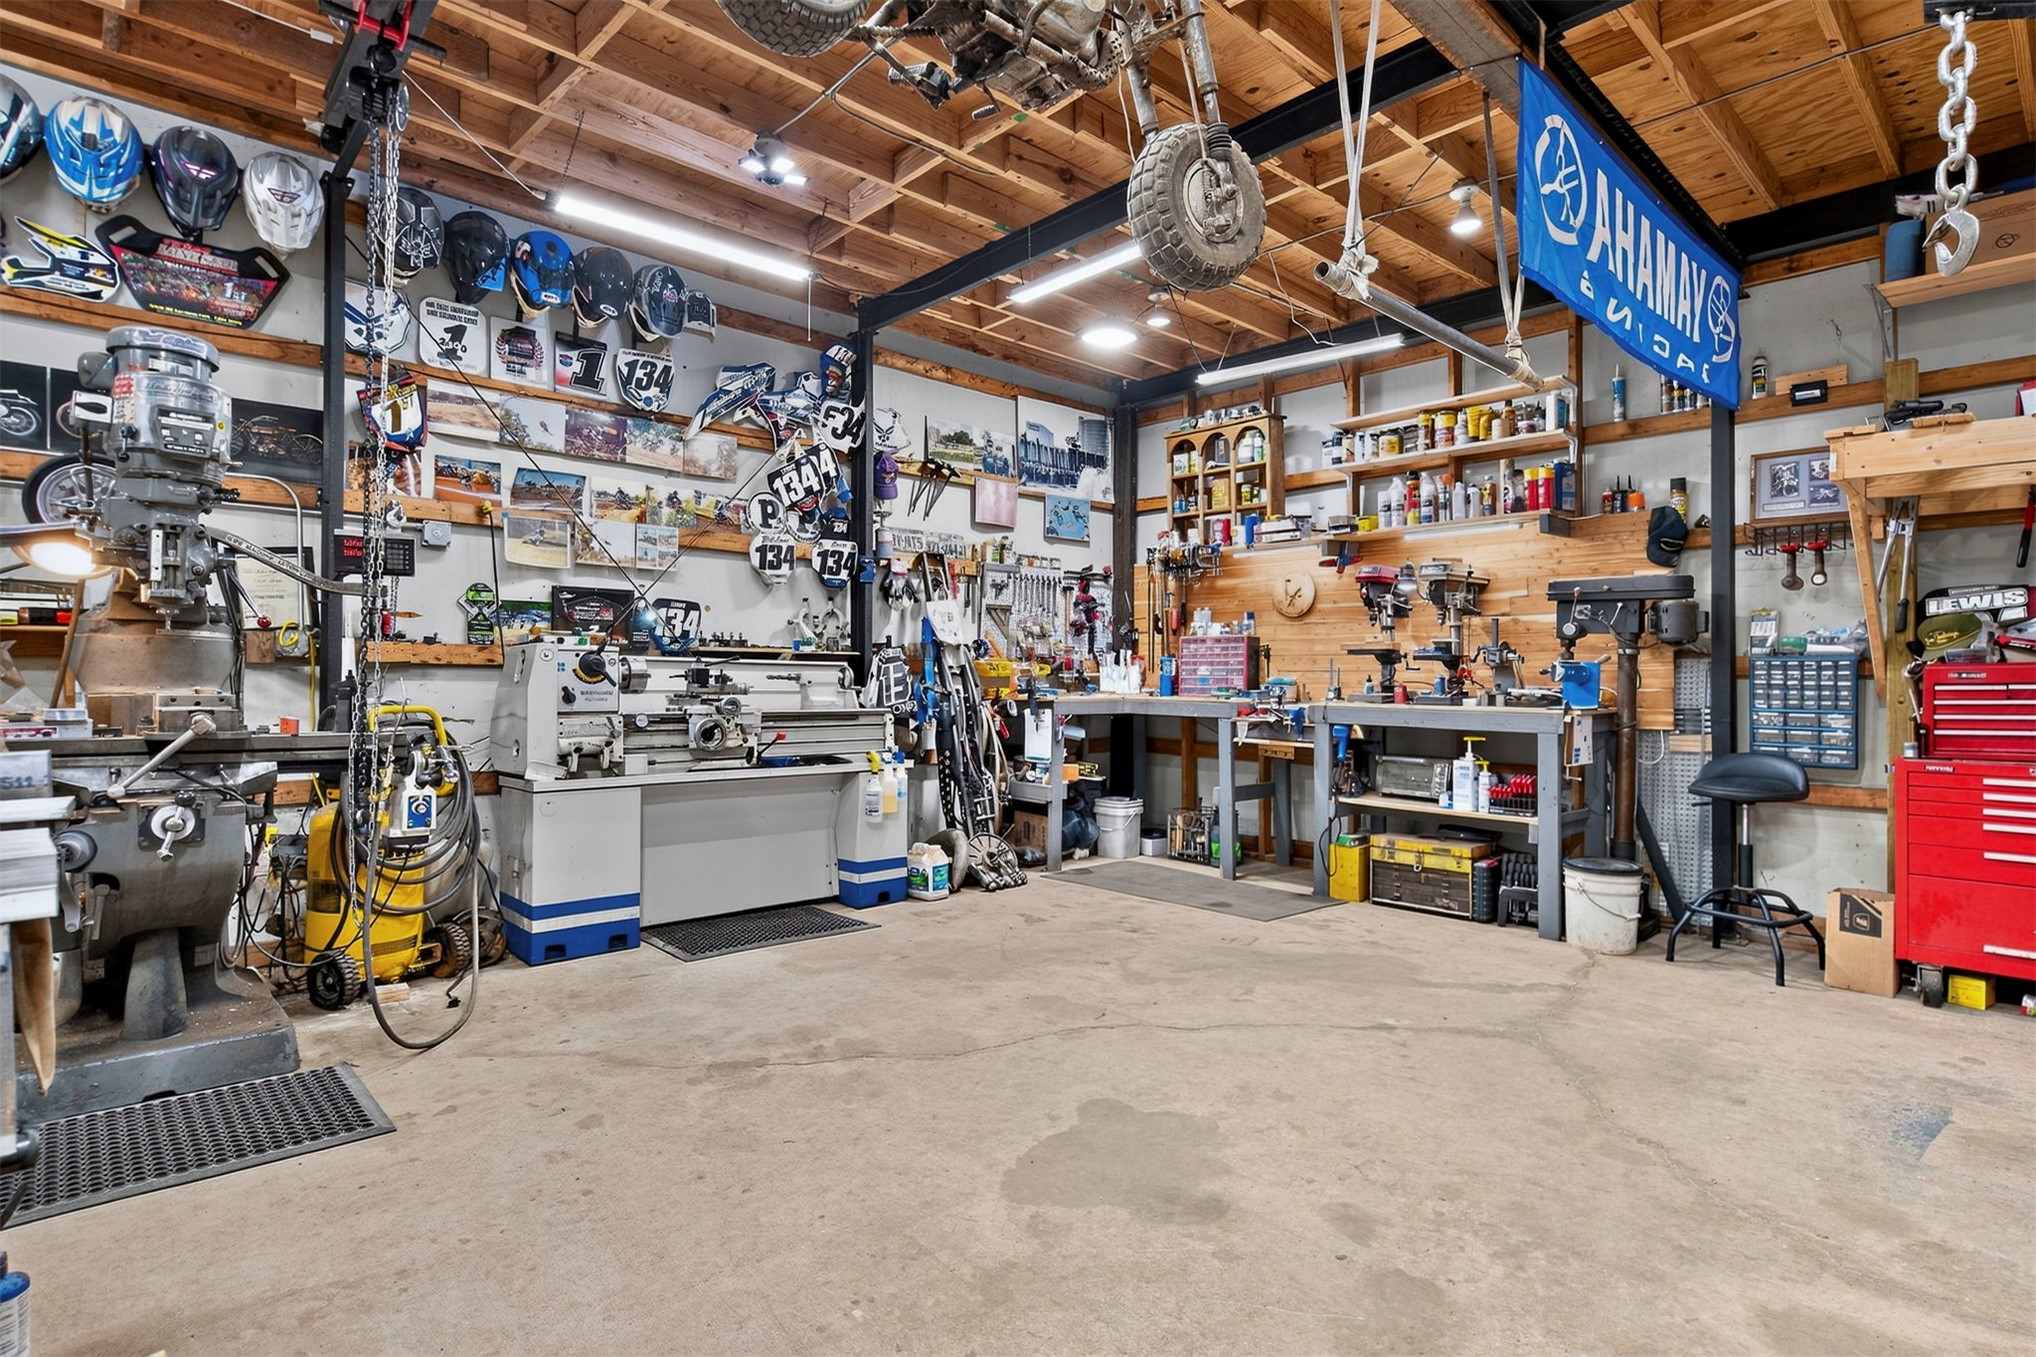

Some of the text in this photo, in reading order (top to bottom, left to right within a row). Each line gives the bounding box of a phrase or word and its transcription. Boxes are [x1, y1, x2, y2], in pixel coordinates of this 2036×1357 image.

[570, 348, 606, 392] 1
[623, 358, 672, 394] 134
[773, 462, 821, 507] 134
[755, 544, 795, 571] 134
[817, 548, 857, 578] 134
[1926, 588, 2027, 616] LEWIS
[654, 607, 700, 638] 134
